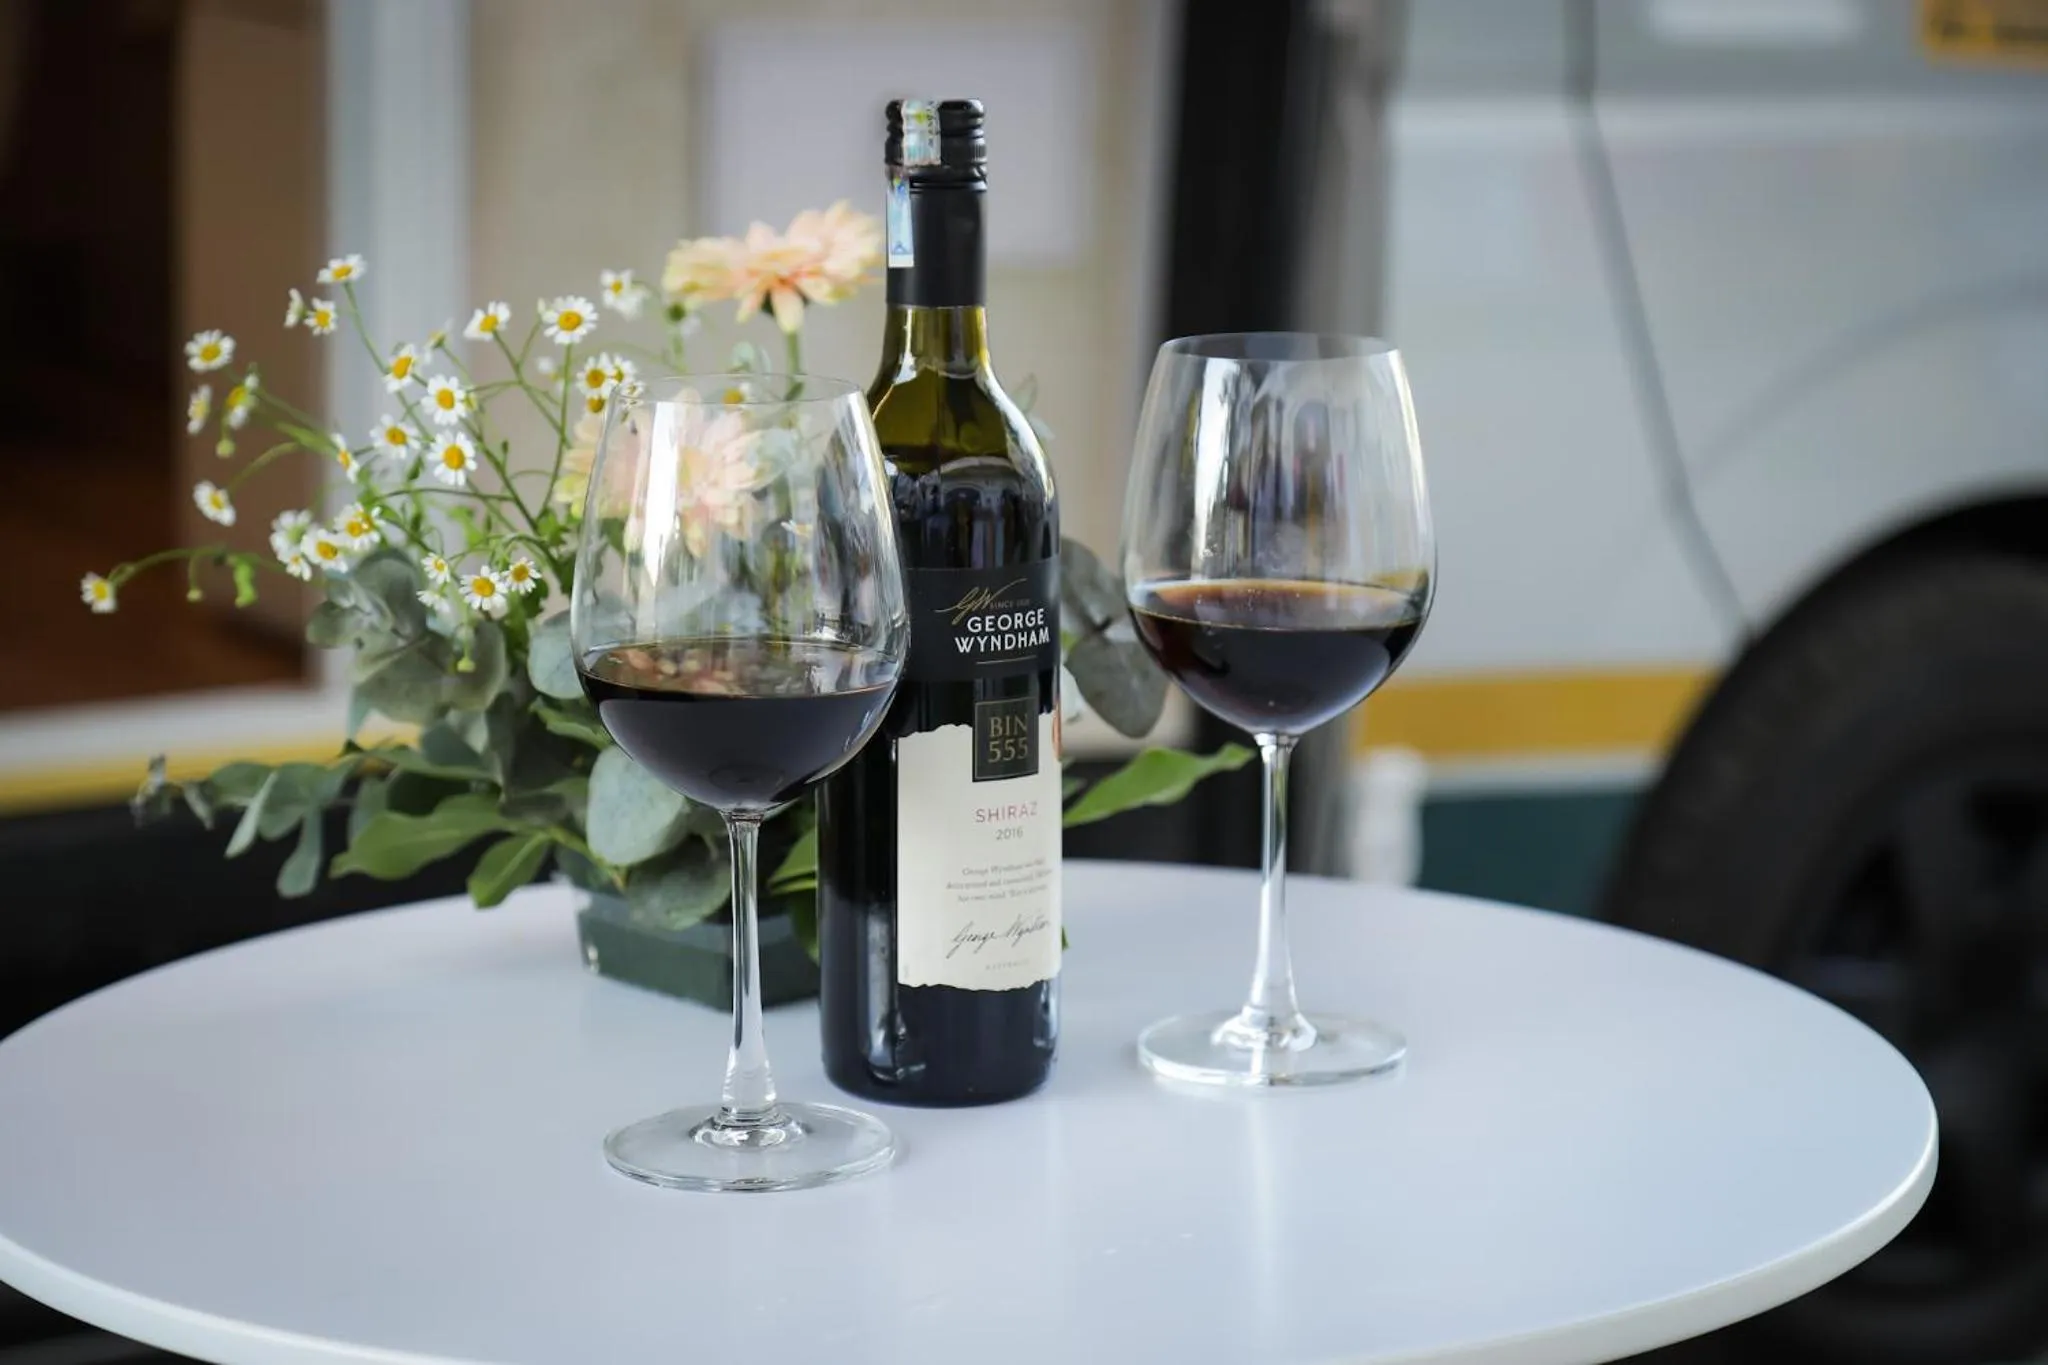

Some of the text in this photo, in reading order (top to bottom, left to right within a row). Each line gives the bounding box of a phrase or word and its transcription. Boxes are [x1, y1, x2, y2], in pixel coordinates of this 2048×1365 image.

[967, 608, 1045, 633] GEORGE
[954, 626, 1050, 654] WYNDHAM
[989, 713, 1029, 738] BIN
[987, 736, 1028, 763] 555
[975, 801, 1039, 823] SHIRAZ
[995, 826, 1024, 841] 2016
